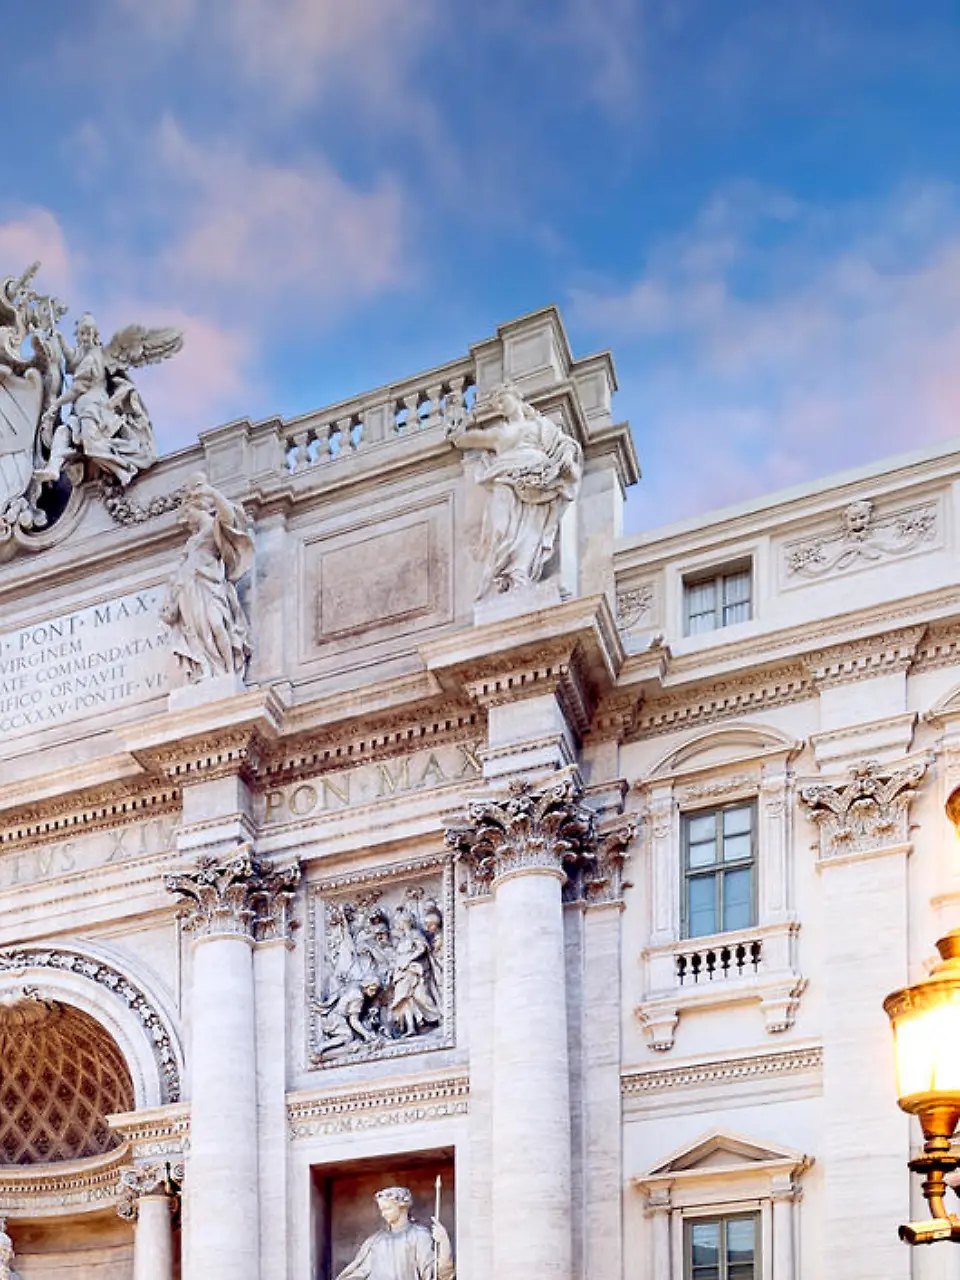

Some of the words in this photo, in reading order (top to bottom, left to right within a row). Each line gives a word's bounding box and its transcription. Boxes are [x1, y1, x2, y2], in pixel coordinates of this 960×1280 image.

[0, 639, 83, 674] VIRGINEM
[36, 632, 170, 683] COMMENDATAM
[50, 664, 127, 698] ORNAVIT
[376, 740, 483, 797] MAX
